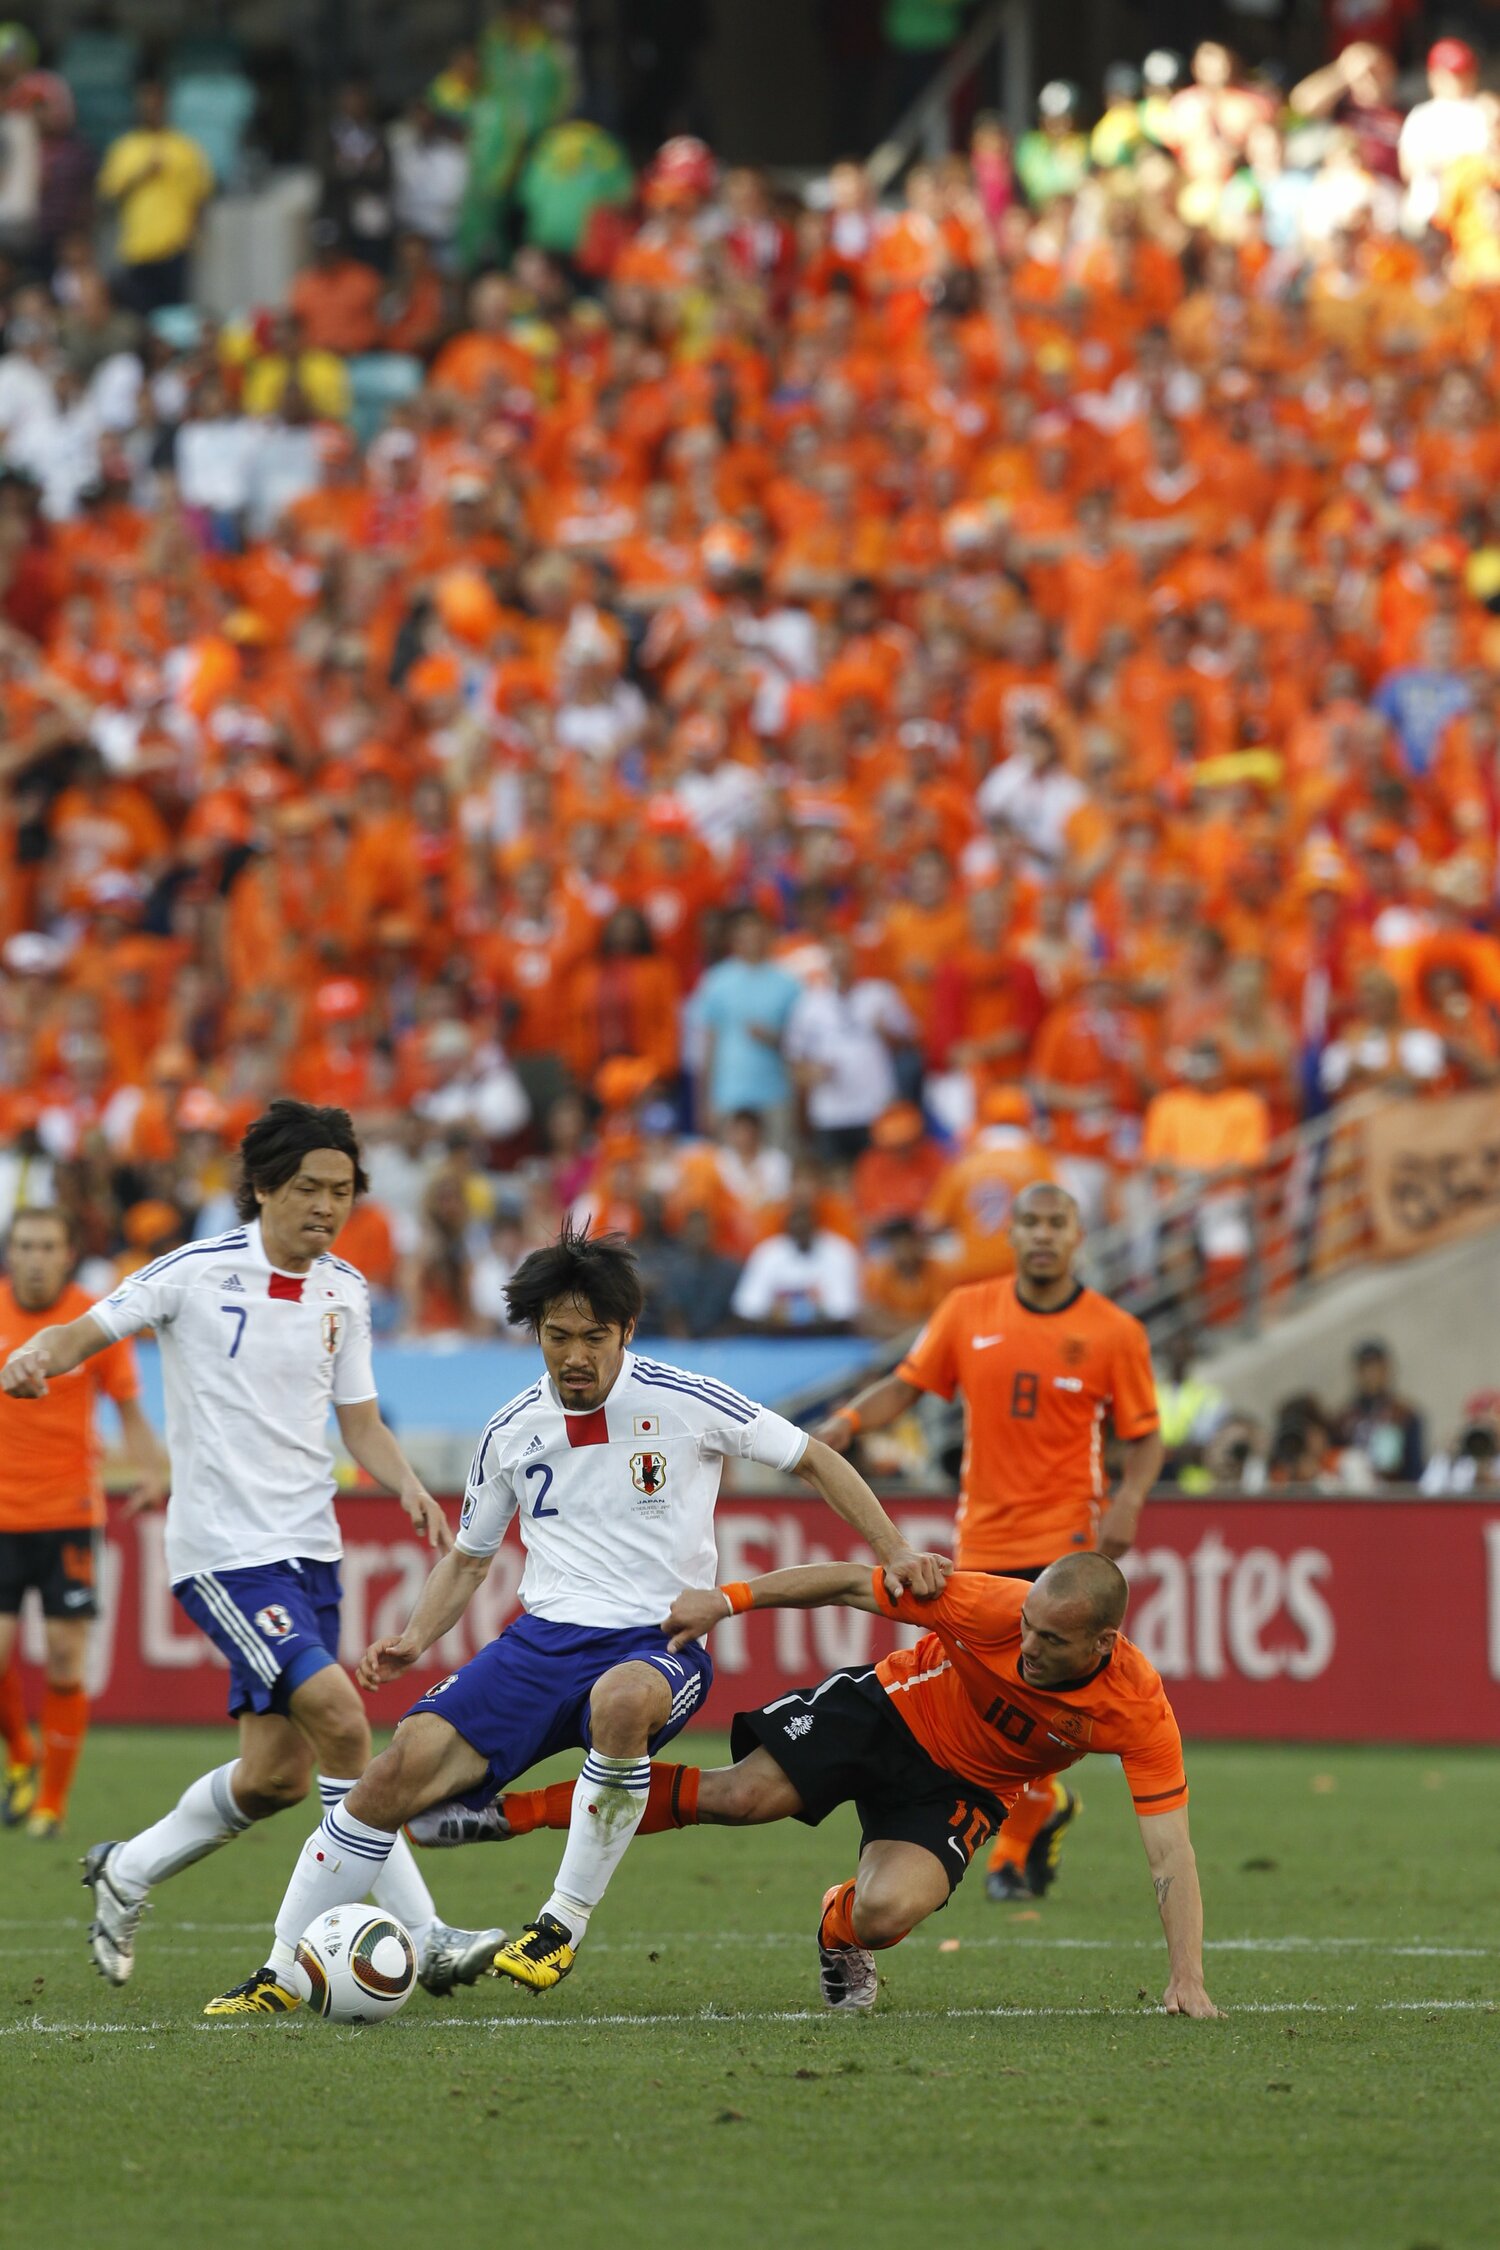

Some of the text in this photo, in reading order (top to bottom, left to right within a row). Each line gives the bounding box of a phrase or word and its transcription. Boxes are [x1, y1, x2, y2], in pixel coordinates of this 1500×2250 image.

[221, 1305, 247, 1359] 7
[1010, 1371, 1039, 1420] 8
[525, 1463, 559, 1519] 2
[982, 1695, 1037, 1746] 10
[948, 1799, 991, 1861] 10
